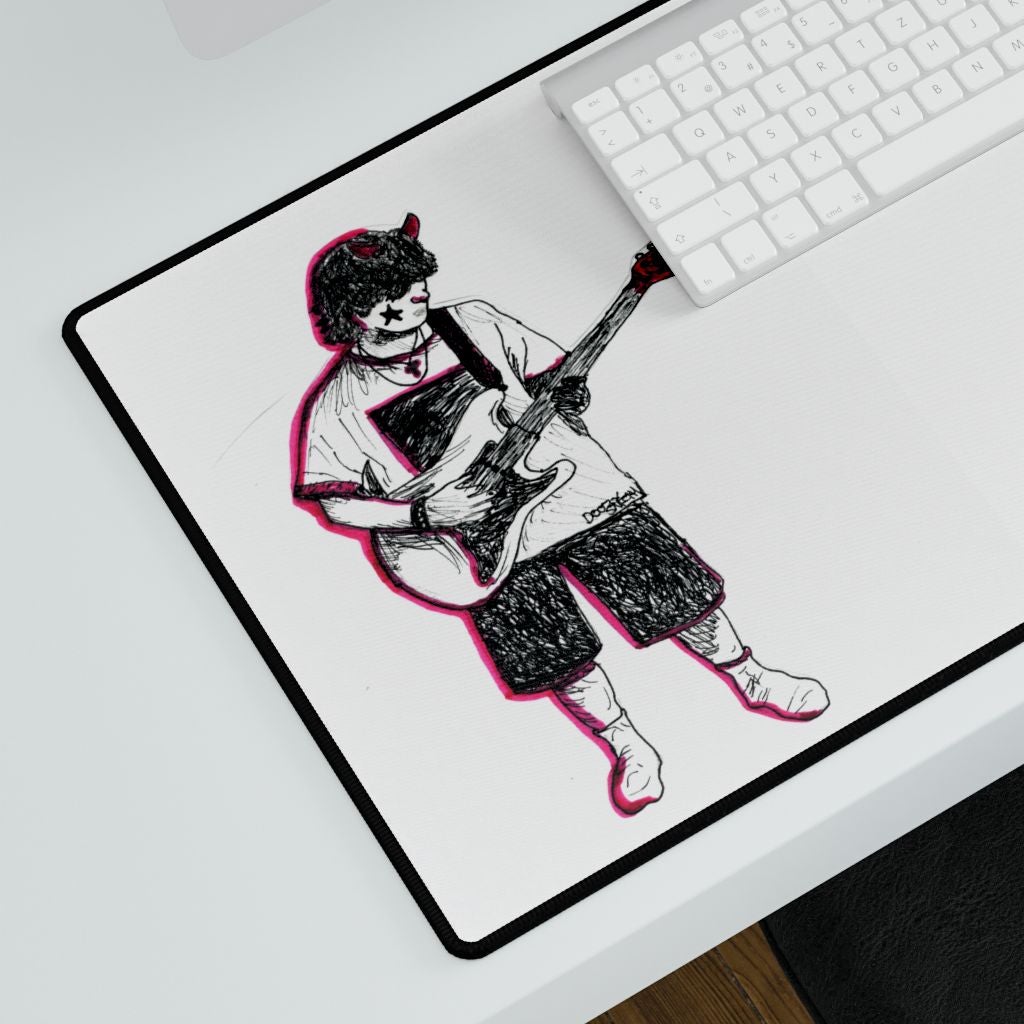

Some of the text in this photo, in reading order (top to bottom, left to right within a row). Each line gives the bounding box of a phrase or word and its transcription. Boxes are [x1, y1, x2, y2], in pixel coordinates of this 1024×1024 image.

[635, 105, 644, 114] 1
[677, 83, 687, 93] 2
[718, 61, 727, 71] 3
[760, 39, 768, 47] 4
[799, 17, 808, 26] 5
[694, 127, 706, 138] Q
[732, 104, 747, 117] W
[775, 83, 786, 94] E
[816, 61, 827, 72] R
[856, 39, 865, 49] T
[896, 17, 908, 28] Z
[726, 151, 736, 162] A
[766, 129, 776, 139] S
[805, 106, 817, 117] D
[847, 84, 856, 95] F
[887, 62, 898, 72] G
[926, 39, 939, 50] H
[969, 18, 977, 29] J
[768, 172, 778, 183] Y
[809, 150, 822, 162] X
[851, 128, 862, 138] C
[890, 105, 900, 116] V
[931, 84, 942, 94] B
[971, 61, 984, 72] N
[1011, 39, 1024, 51] M
